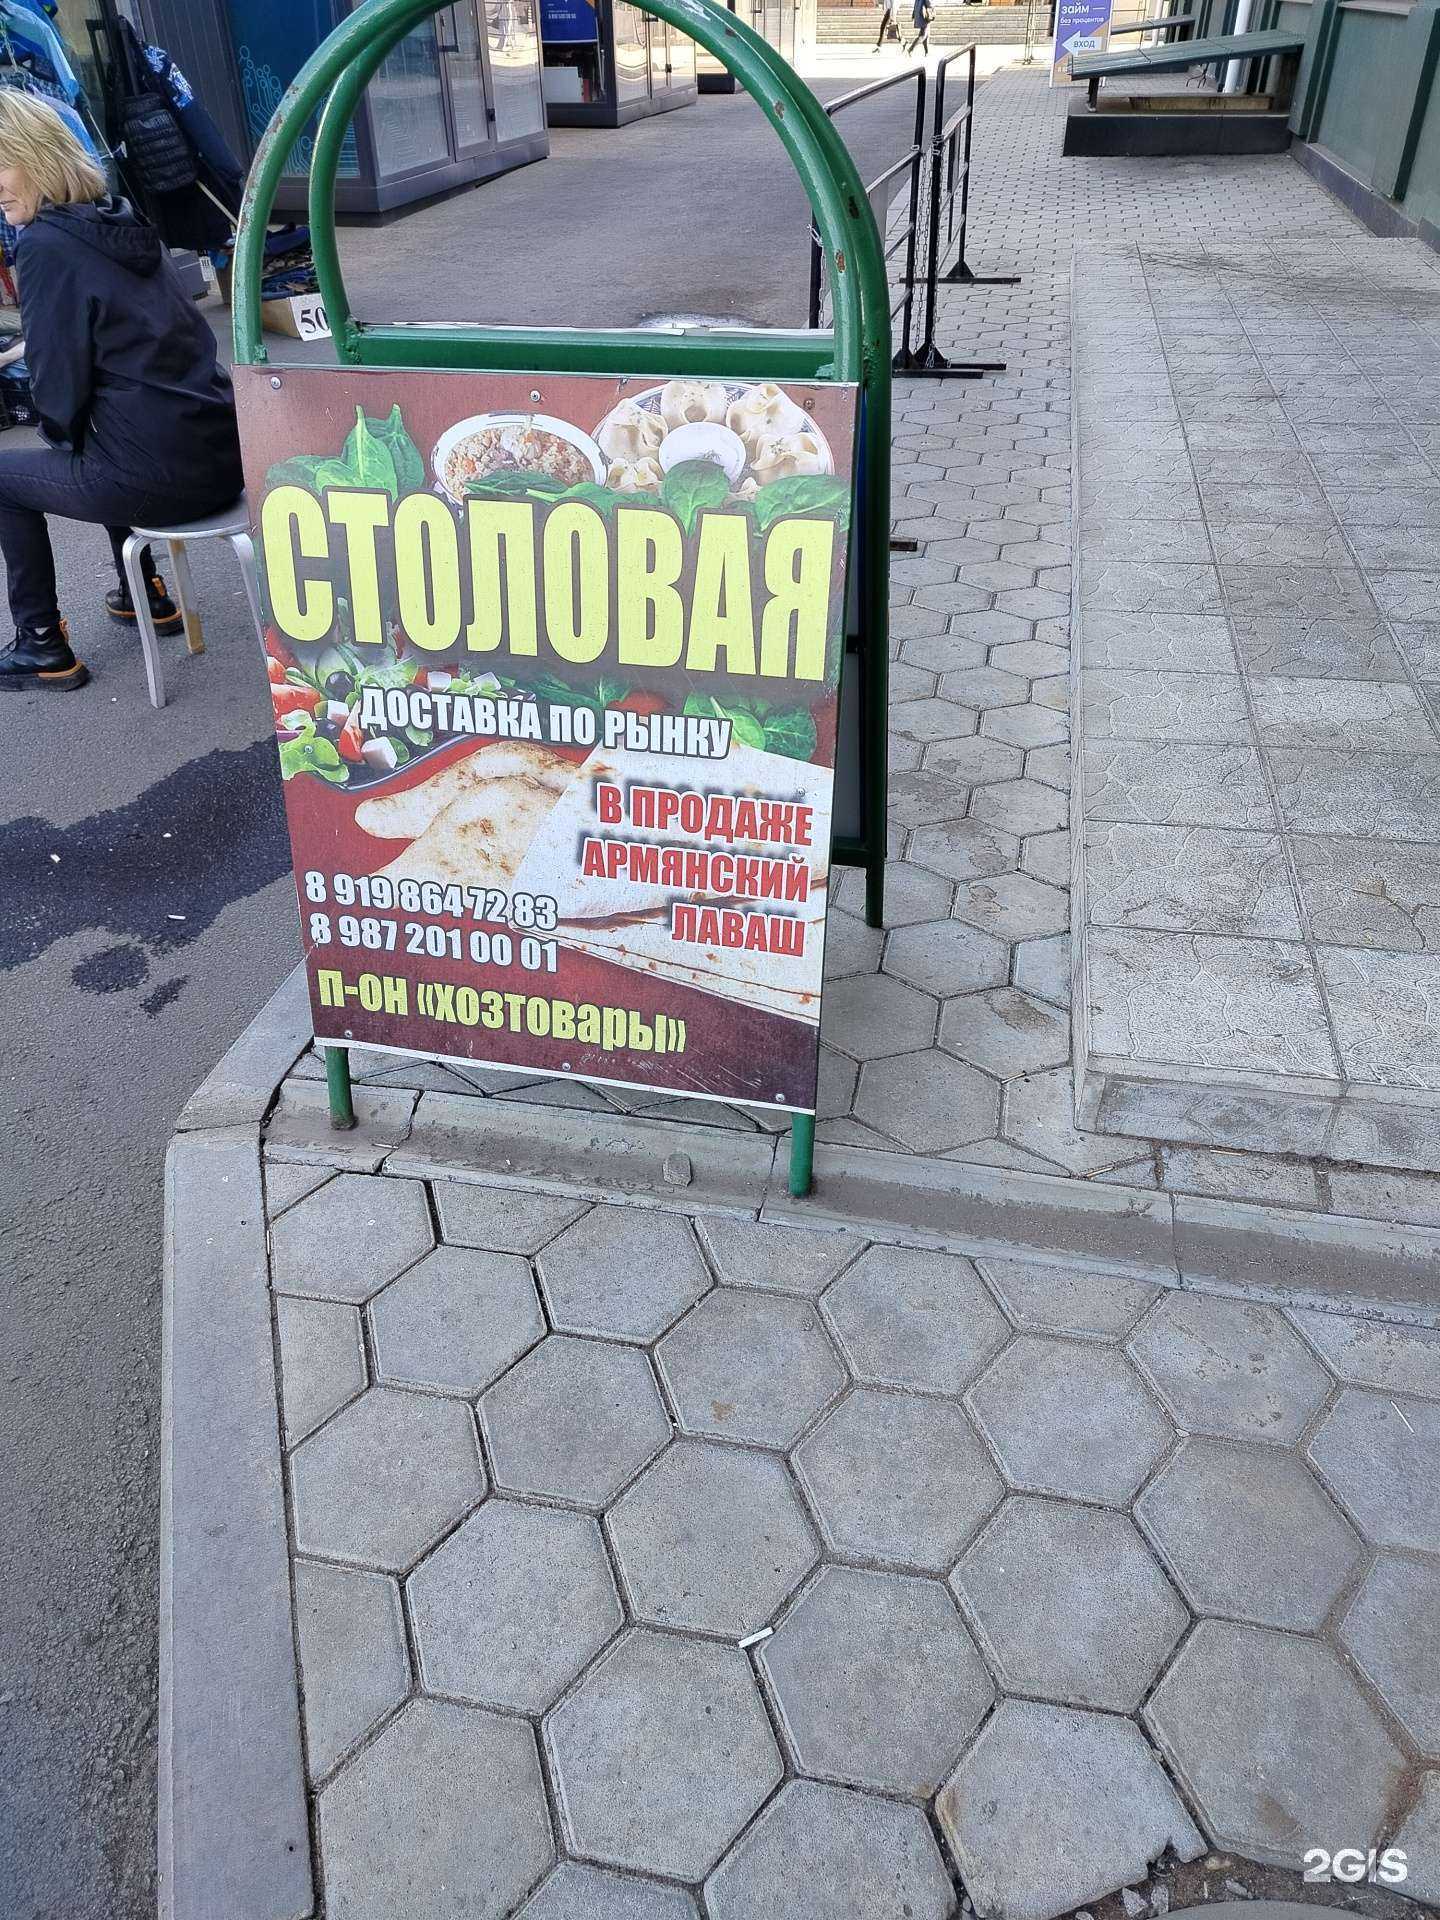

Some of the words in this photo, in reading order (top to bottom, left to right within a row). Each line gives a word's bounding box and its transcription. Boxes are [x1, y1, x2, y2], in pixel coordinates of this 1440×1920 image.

[1060, 17, 1071, 25] без
[1072, 17, 1104, 25] процентов
[1061, 2, 1089, 14] займ
[261, 485, 837, 682] СТОЛОВАЯ
[360, 687, 543, 740] ДОСТАВКА
[549, 704, 596, 745] ПО
[604, 709, 731, 758] РЫНКУ
[599, 785, 623, 824] В
[632, 788, 814, 846] ПРОДАЖЕ
[304, 871, 327, 903] 8
[333, 873, 394, 910] 919
[399, 878, 465, 918] 864
[469, 888, 508, 924] 72
[513, 894, 558, 930] 83
[583, 840, 809, 903] АРМЯНСКИЙ
[309, 912, 332, 948] 8
[338, 915, 398, 951] 987
[405, 922, 462, 961] 201
[469, 930, 513, 966] 00
[520, 937, 558, 973] 01
[671, 905, 806, 958] ЛАВАШ
